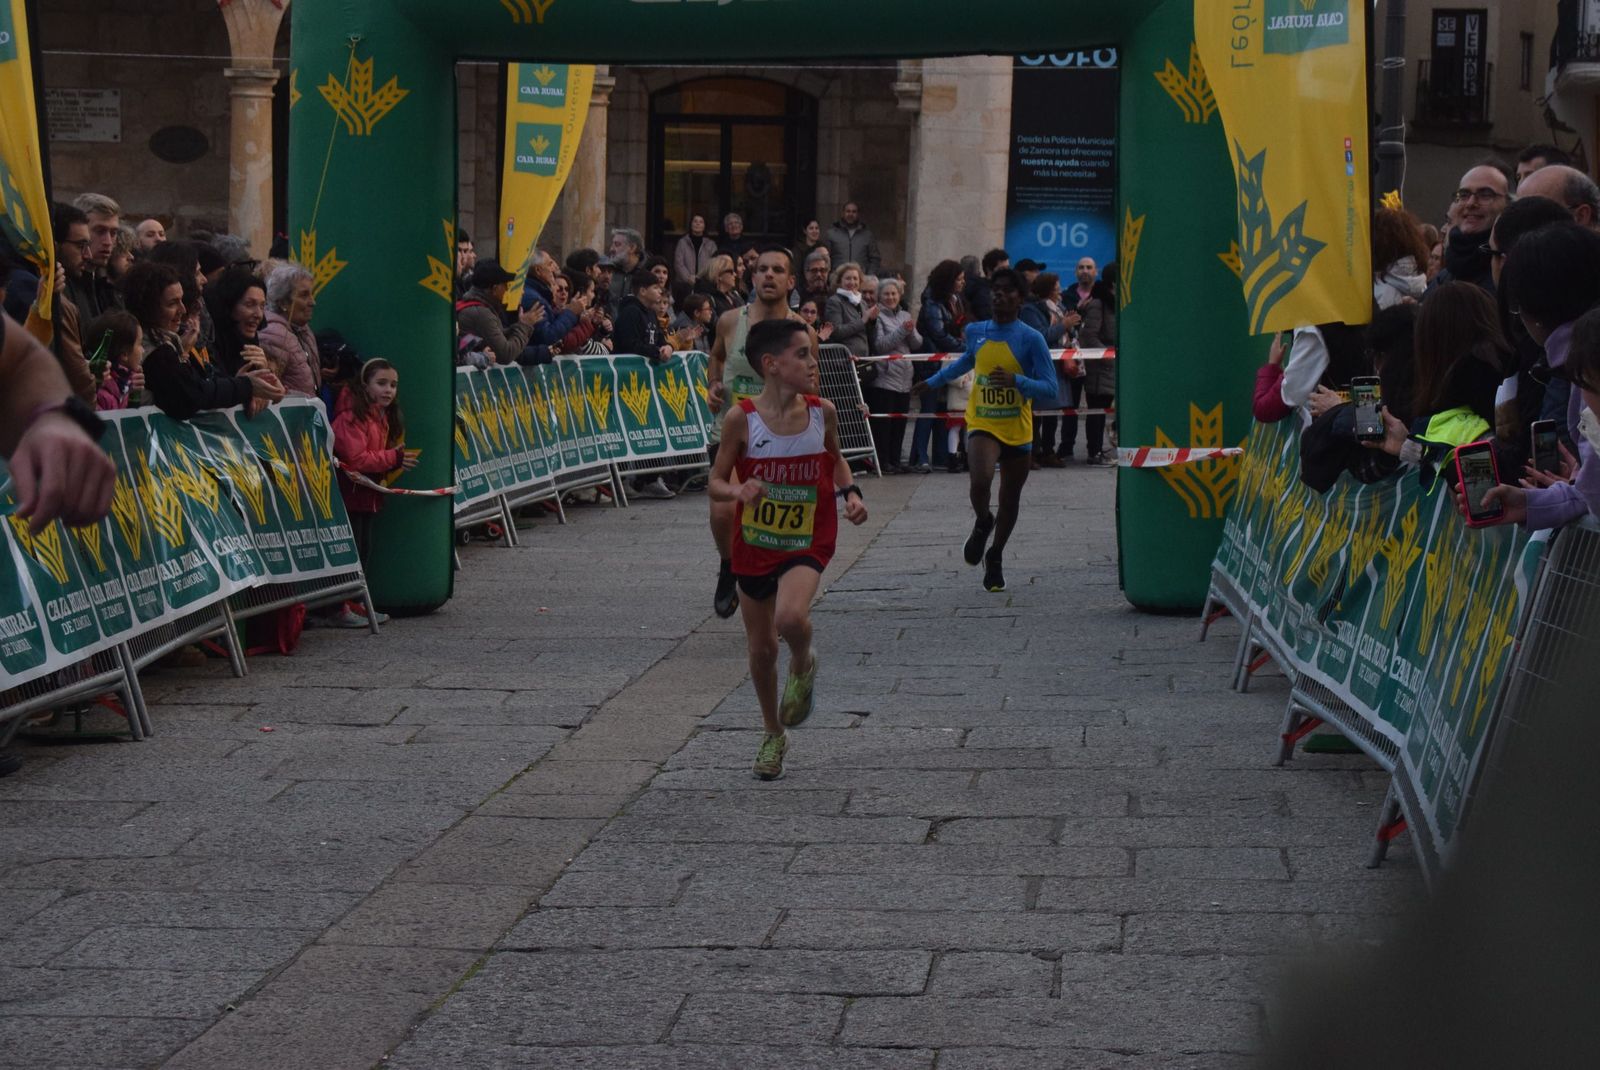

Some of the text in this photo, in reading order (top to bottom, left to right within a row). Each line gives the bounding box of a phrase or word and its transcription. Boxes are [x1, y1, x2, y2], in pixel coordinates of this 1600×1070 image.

[1439, 17, 1455, 30] SE
[520, 86, 564, 97] CAJA RURAL
[1017, 135, 1042, 144] Desde
[1043, 135, 1051, 144] la
[1078, 136, 1116, 146] Municipal
[1030, 146, 1060, 155] Zamora
[1062, 148, 1069, 156] te
[1071, 148, 1113, 157] ofrecemos
[516, 155, 557, 165] CAJA RURAL
[1021, 158, 1110, 168] nuestra ayuda cuando
[1033, 169, 1097, 178] más la necesitas
[1036, 221, 1088, 248] 016
[980, 387, 1015, 405] 1050
[629, 427, 664, 440] CAJA RURAL
[669, 427, 682, 437] CAJA
[682, 425, 701, 434] RURAL
[752, 501, 804, 529] 1073
[286, 529, 302, 546] CAJA
[330, 524, 352, 541] RURAL
[759, 534, 808, 547] CAJA RURAL
[46, 596, 72, 623] CAJA
[61, 620, 76, 636] DE
